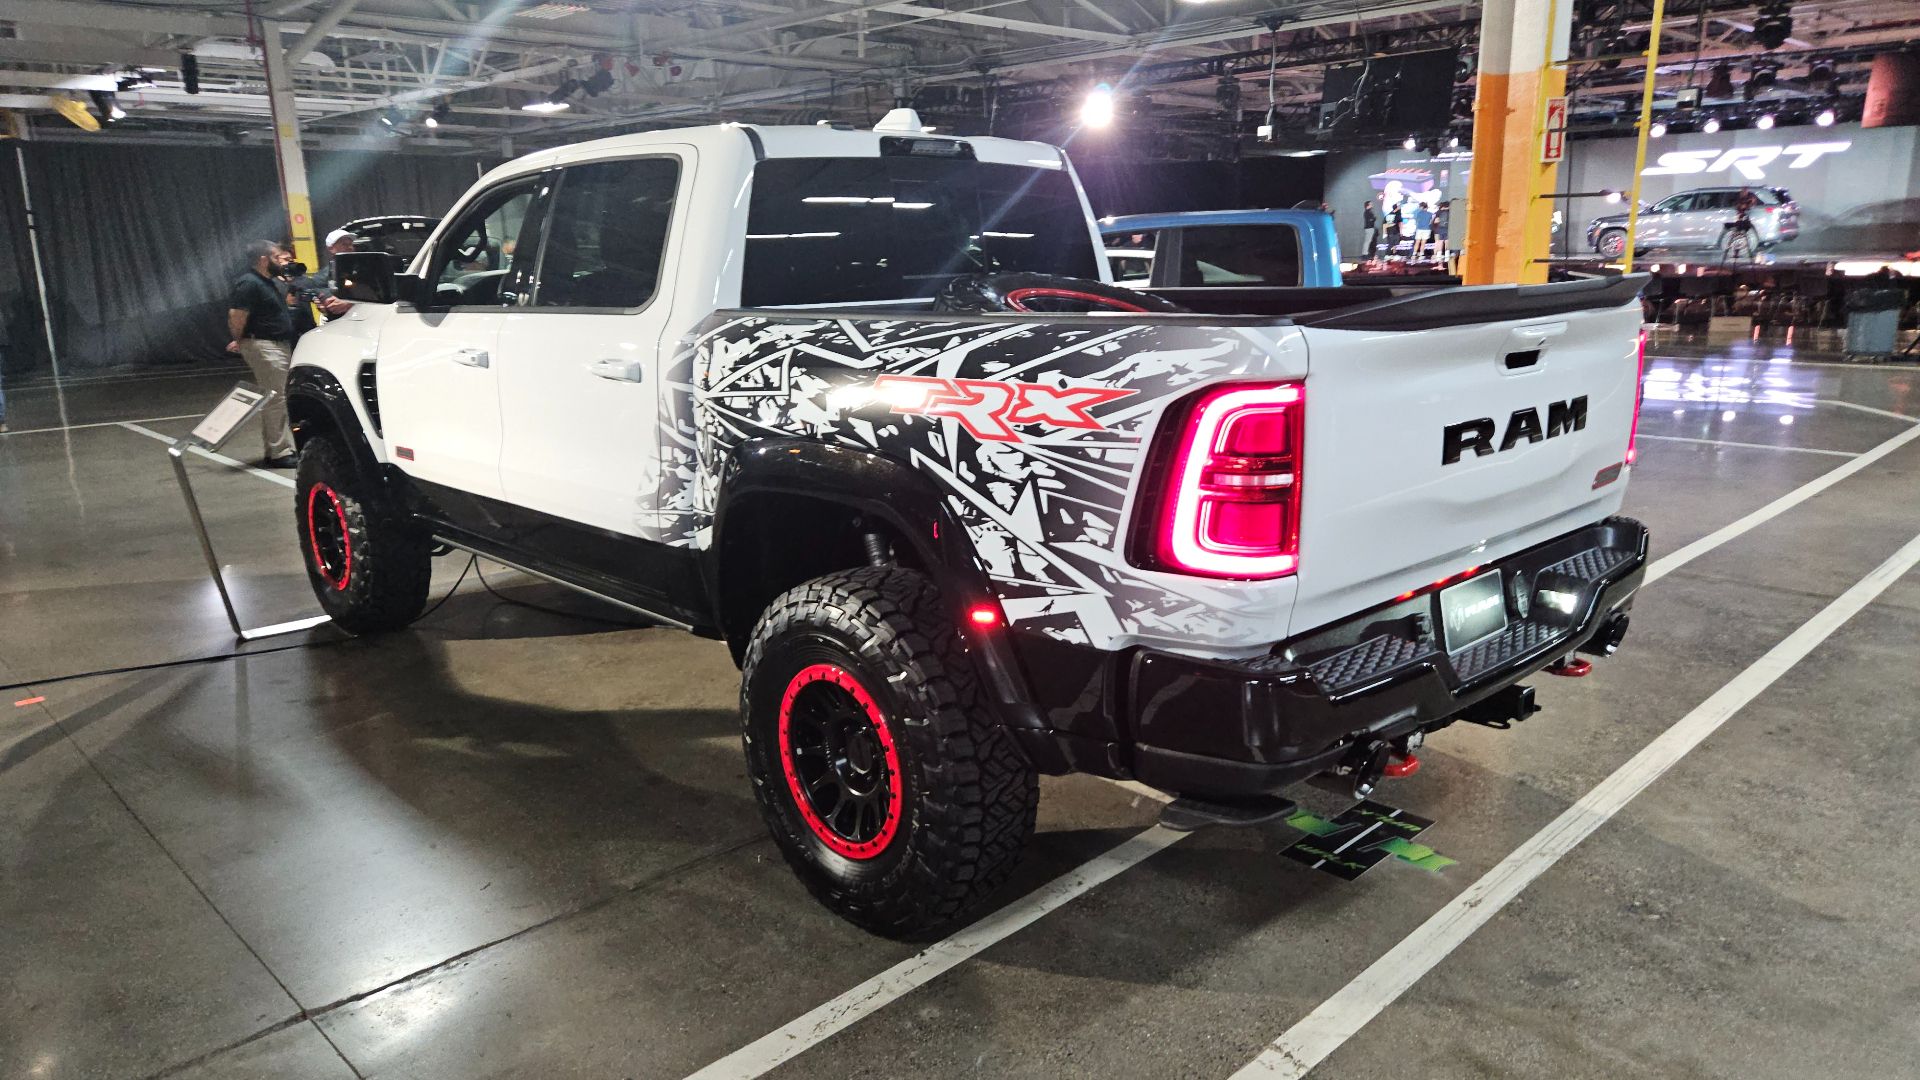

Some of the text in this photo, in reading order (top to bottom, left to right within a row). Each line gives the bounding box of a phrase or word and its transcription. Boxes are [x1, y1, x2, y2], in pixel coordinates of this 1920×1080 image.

[1640, 141, 1852, 179] SRT
[873, 374, 1141, 443] TRX
[1441, 394, 1588, 466] RAM
